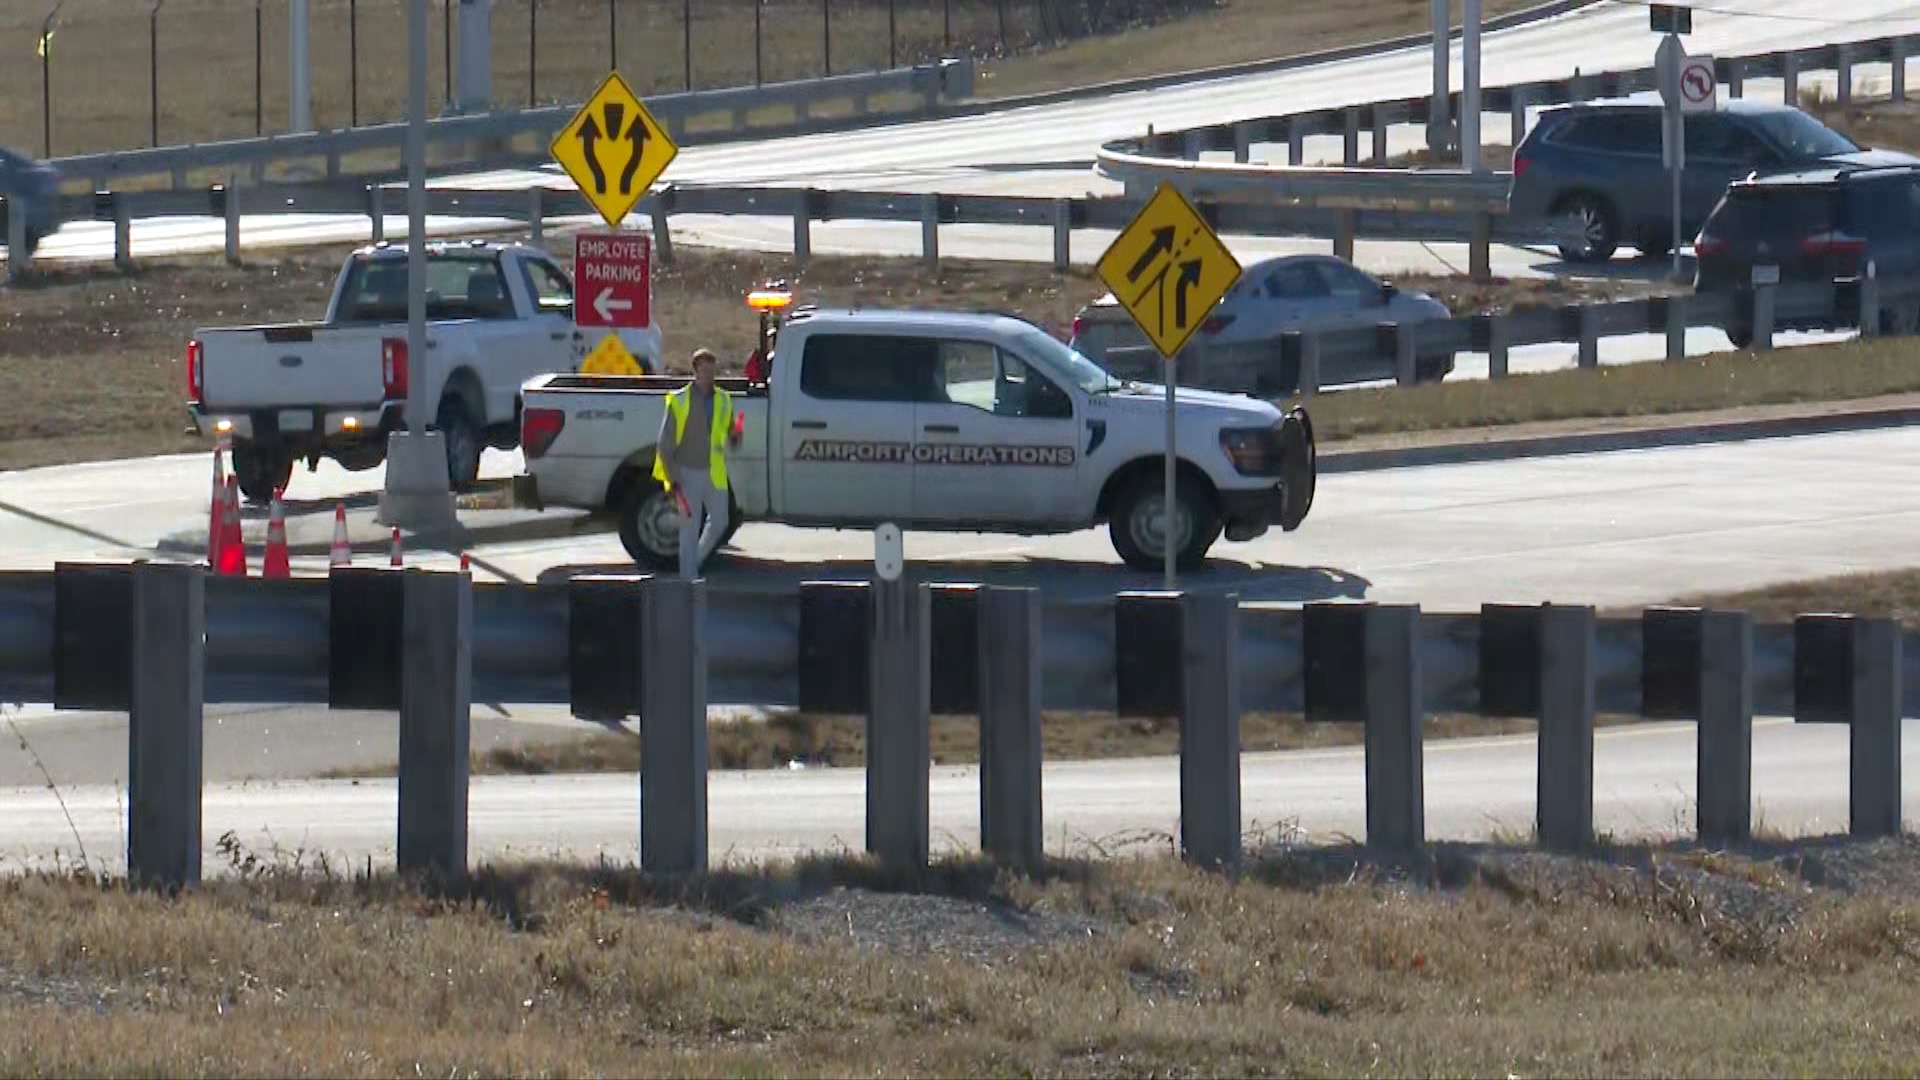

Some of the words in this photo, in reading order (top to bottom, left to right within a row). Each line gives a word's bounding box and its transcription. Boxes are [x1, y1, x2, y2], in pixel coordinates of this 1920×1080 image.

[579, 240, 646, 259] EMPLOYEE
[585, 262, 642, 282] PARKING
[797, 440, 910, 462] AIRPORT
[912, 444, 1075, 466] OPERATIONS
